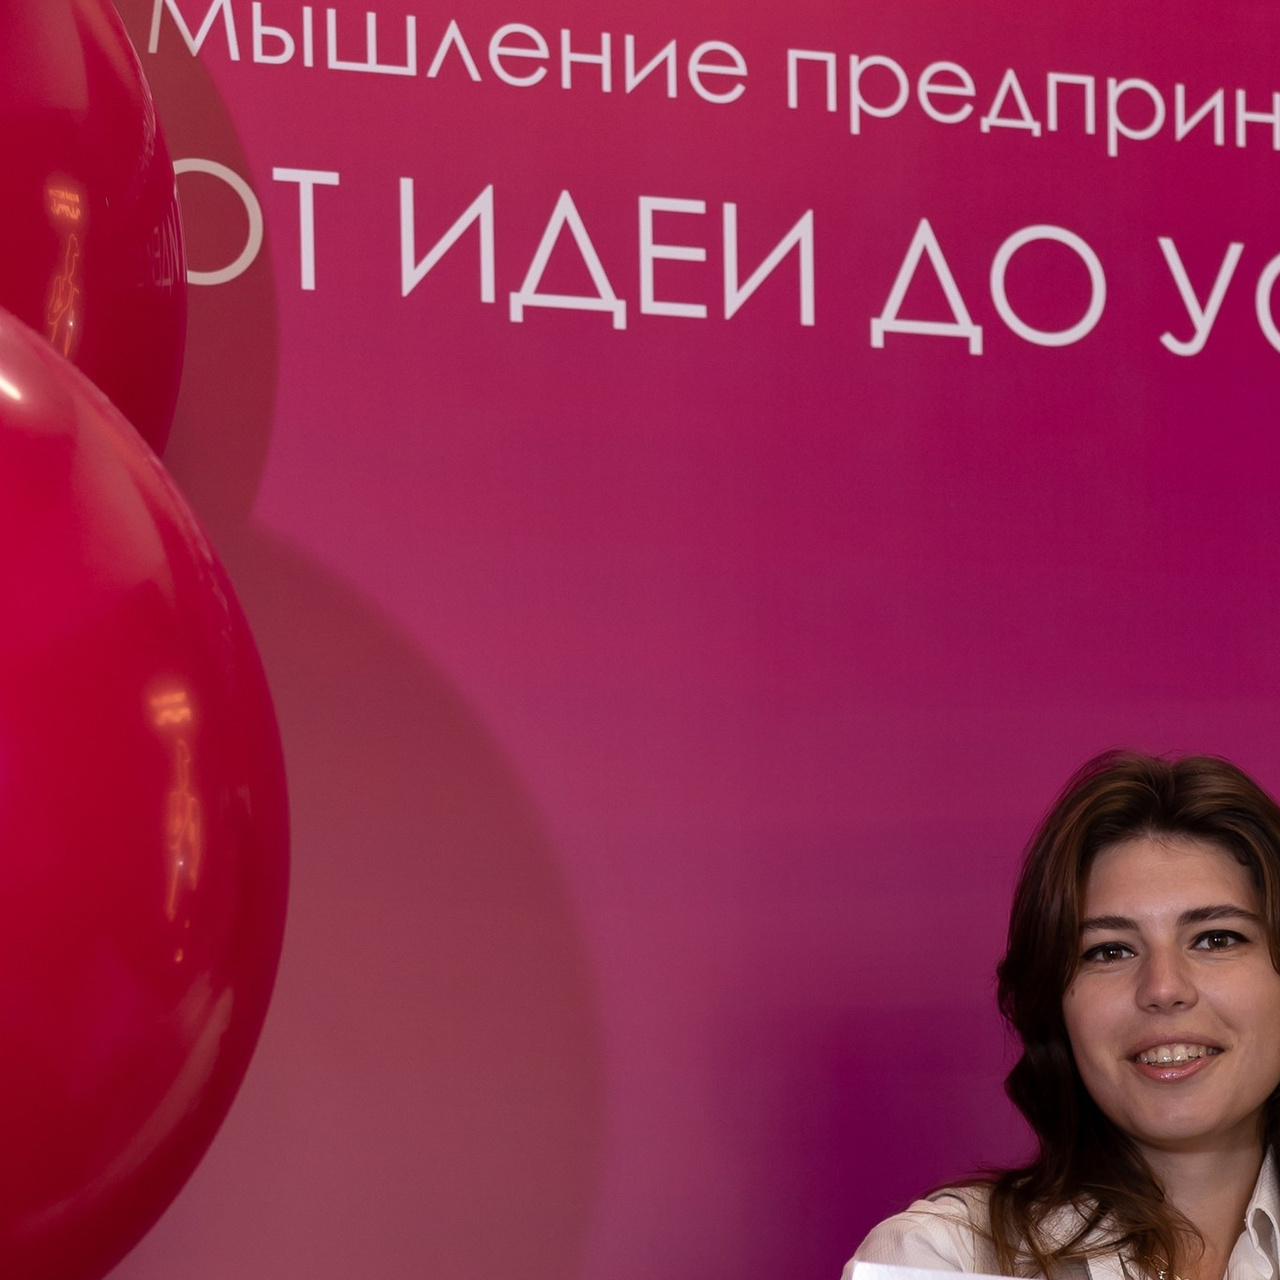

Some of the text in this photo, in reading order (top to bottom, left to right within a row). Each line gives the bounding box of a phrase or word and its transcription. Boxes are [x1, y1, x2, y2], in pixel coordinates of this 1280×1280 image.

[149, 0, 748, 104] Мышление
[173, 158, 340, 291] ОТ
[400, 177, 815, 329] ИДЕИ
[870, 217, 1107, 356] ДО
